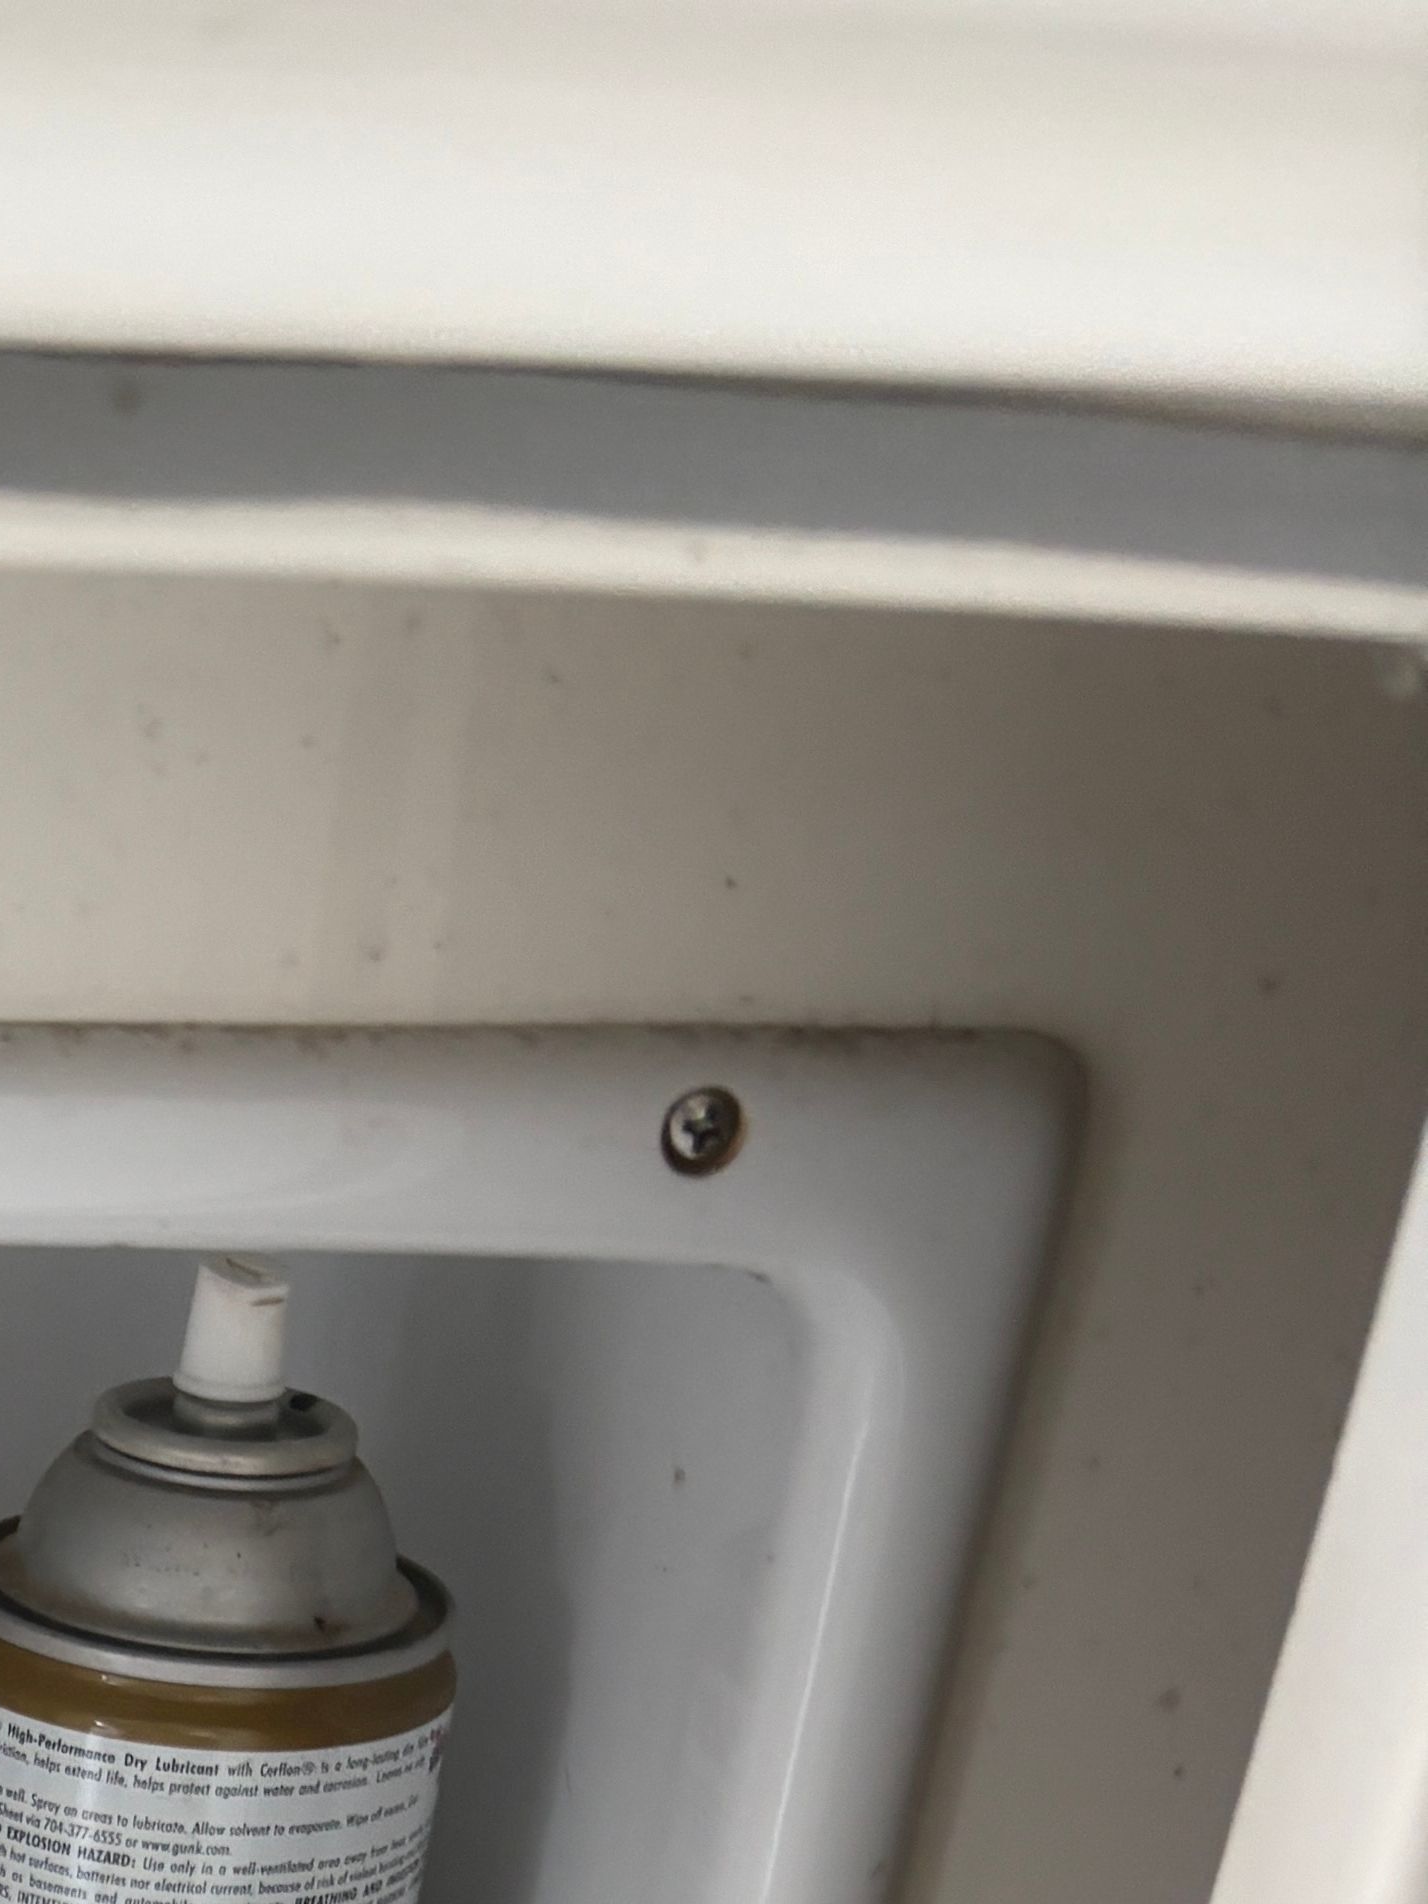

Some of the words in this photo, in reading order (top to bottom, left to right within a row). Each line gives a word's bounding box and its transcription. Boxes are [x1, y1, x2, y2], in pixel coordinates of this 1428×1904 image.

[7, 1723, 115, 1764] High-Performance
[124, 1753, 148, 1771] Dry
[156, 1757, 219, 1776] Lubricant
[228, 1762, 253, 1776] with
[34, 1756, 60, 1774] helps
[64, 1764, 101, 1781] extend
[133, 1776, 164, 1792] helps
[169, 1780, 211, 1796] protect
[215, 1783, 258, 1799] against
[264, 1783, 294, 1797] water
[299, 1781, 320, 1795] and
[32, 1795, 60, 1815] Spray
[83, 1808, 113, 1826] areas
[117, 1815, 128, 1827] to
[132, 1815, 185, 1834] lubricate.
[192, 1822, 226, 1836] Allow
[230, 1824, 271, 1836] solvent
[274, 1824, 285, 1836] to
[43, 1816, 123, 1846] 704-377-6555
[125, 1837, 138, 1848] or
[7, 1827, 71, 1856] EXPLOSION
[78, 1849, 136, 1867] HAZARD:
[143, 1858, 164, 1872] Use
[170, 1862, 196, 1876] only
[201, 1863, 213, 1875] in
[219, 1867, 226, 1875] a
[10, 1847, 25, 1862] hot
[28, 1855, 73, 1879] surfaces,
[77, 1866, 126, 1887] batteries
[131, 1877, 151, 1890] nor
[155, 1878, 206, 1893] electrical
[211, 1883, 252, 1896] current,
[259, 1882, 301, 1895] because
[29, 1873, 87, 1900] basements
[95, 1891, 117, 1904] and
